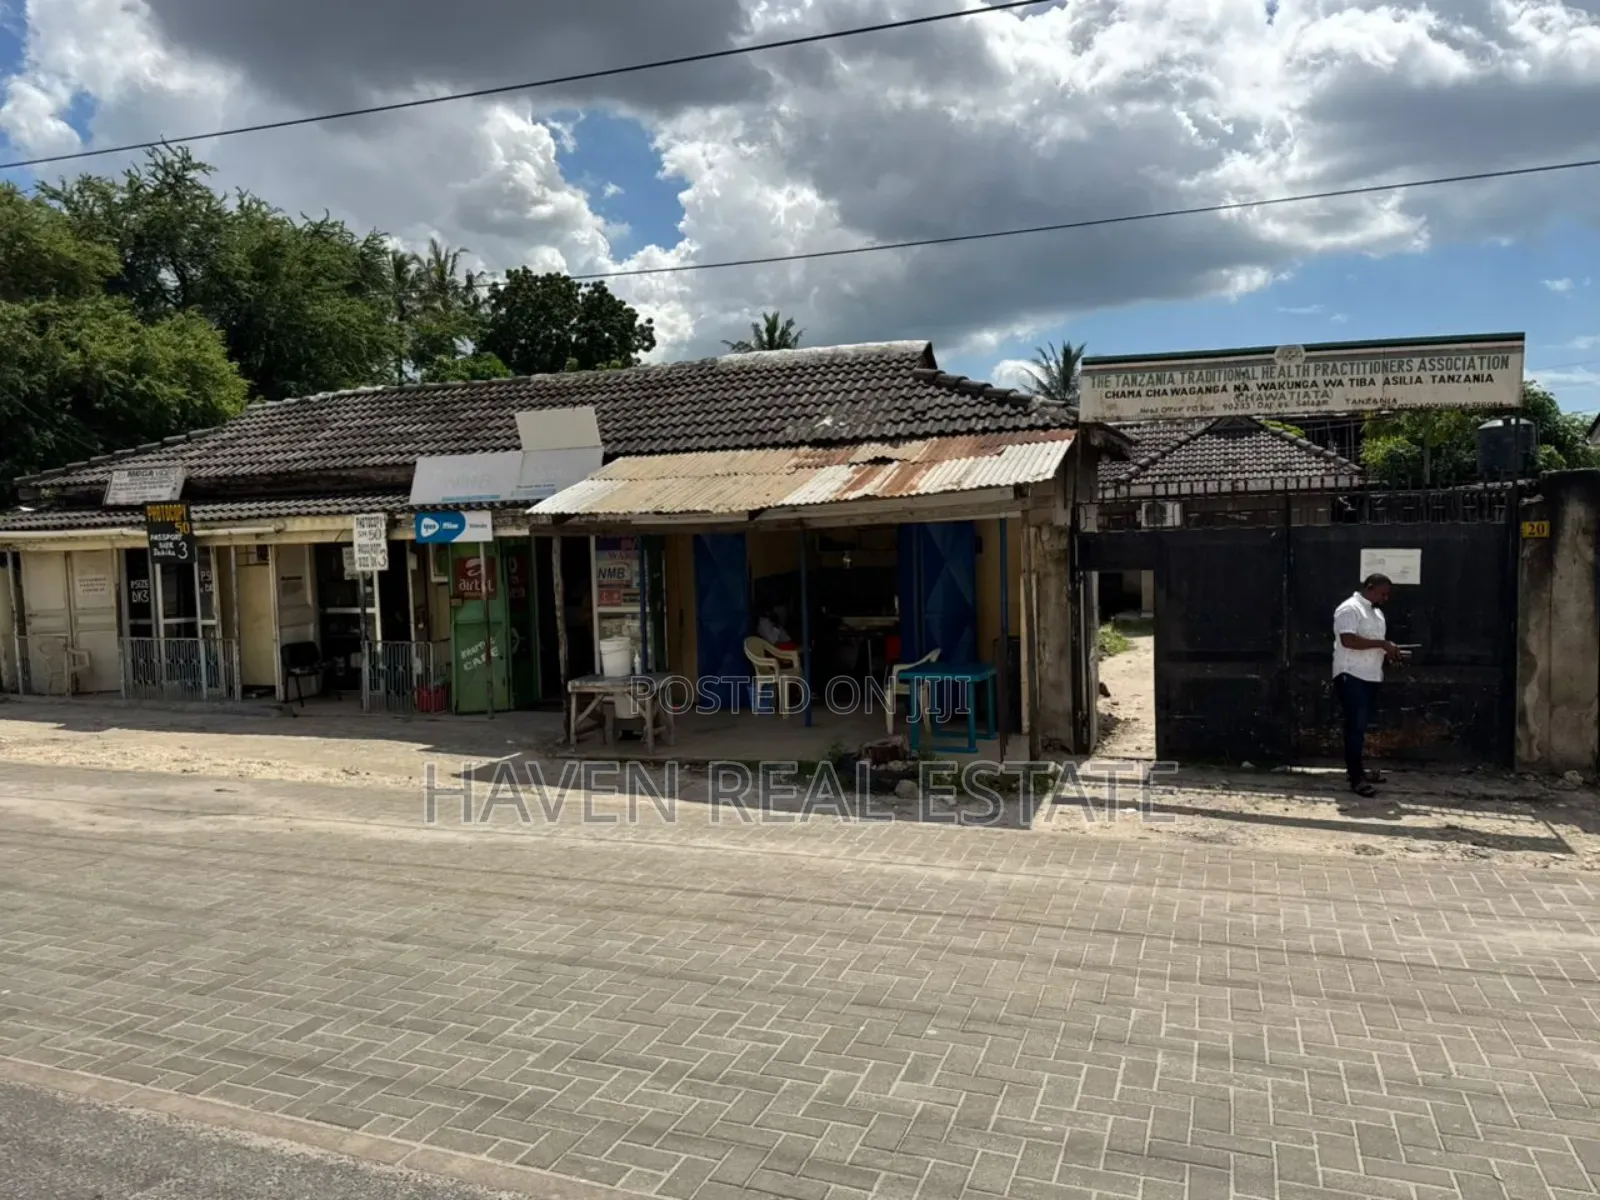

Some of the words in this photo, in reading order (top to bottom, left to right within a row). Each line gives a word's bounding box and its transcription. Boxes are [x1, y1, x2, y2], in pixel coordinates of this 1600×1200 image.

[1090, 374, 1111, 389] THE
[1115, 371, 1175, 388] TANZANIA
[1180, 365, 1258, 384] TRADITIONAL
[1261, 363, 1309, 379] HEALTH
[1315, 359, 1413, 376] PRACTITIONERS
[1417, 355, 1509, 372] ASSOCIATION
[1105, 389, 1142, 399] CHAMA
[1146, 388, 1168, 398] CHA
[1170, 384, 1228, 396] WAGANGA
[1256, 379, 1319, 391] WAKUNGA
[1324, 379, 1344, 388] WA
[1349, 378, 1376, 387] TIBA
[1383, 375, 1423, 386] ASILIA
[1431, 372, 1494, 384] TANZANIA
[1345, 397, 1398, 405] TANZANIA
[174, 521, 190, 535] 50
[368, 529, 381, 540] 50
[1528, 524, 1545, 535] 20
[150, 533, 182, 541] PASSPORT
[177, 541, 189, 560] 3
[378, 548, 387, 567] 3
[598, 567, 625, 579] NMB
